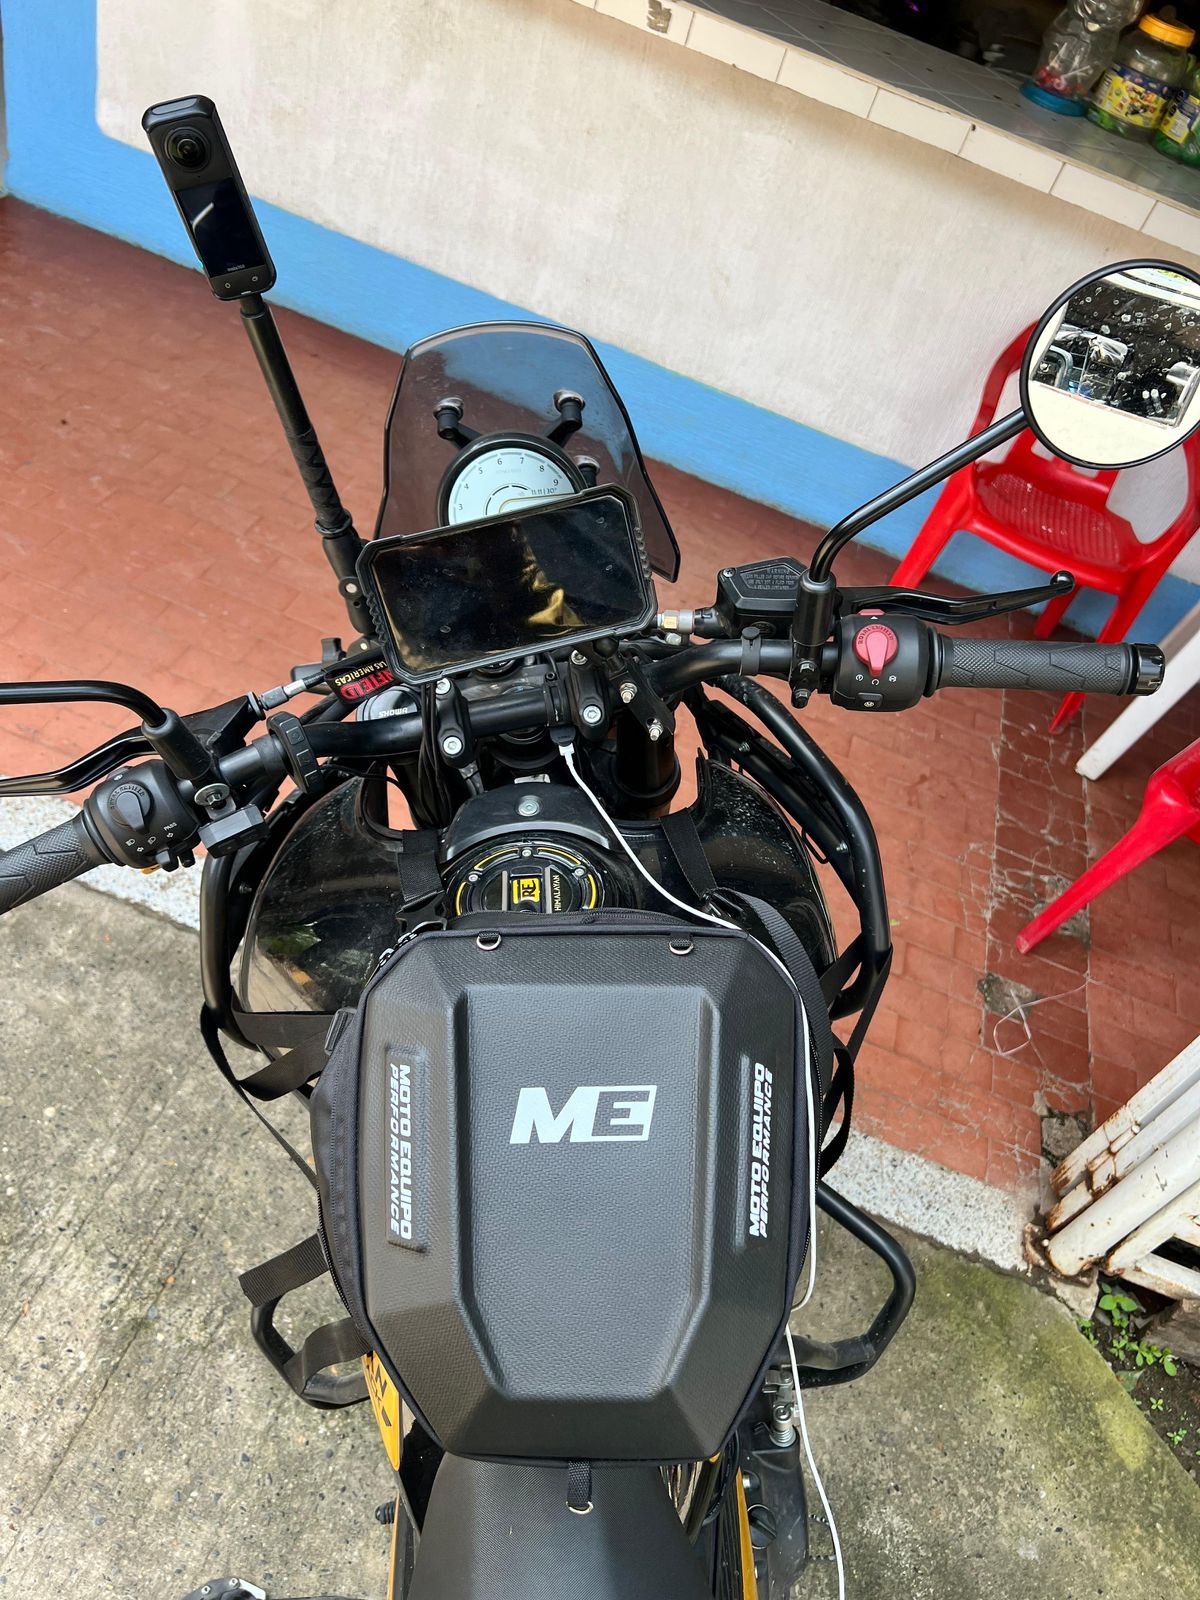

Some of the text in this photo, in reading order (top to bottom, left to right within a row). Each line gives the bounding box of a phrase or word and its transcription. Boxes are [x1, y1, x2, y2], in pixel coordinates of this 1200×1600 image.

[478, 466, 483, 474] 5
[497, 457, 503, 465] 6
[335, 661, 388, 686] LAS AMERICAS
[378, 707, 408, 718] SHOWA
[553, 875, 561, 911] HIMALAYAN
[510, 1085, 657, 1144] ME
[390, 1063, 400, 1235] PERFORMANCE
[399, 1064, 412, 1240] MOTO EQUIPO
[749, 1062, 765, 1237] MOTO EQUIPO
[759, 1067, 773, 1238] PERFORMANCE
